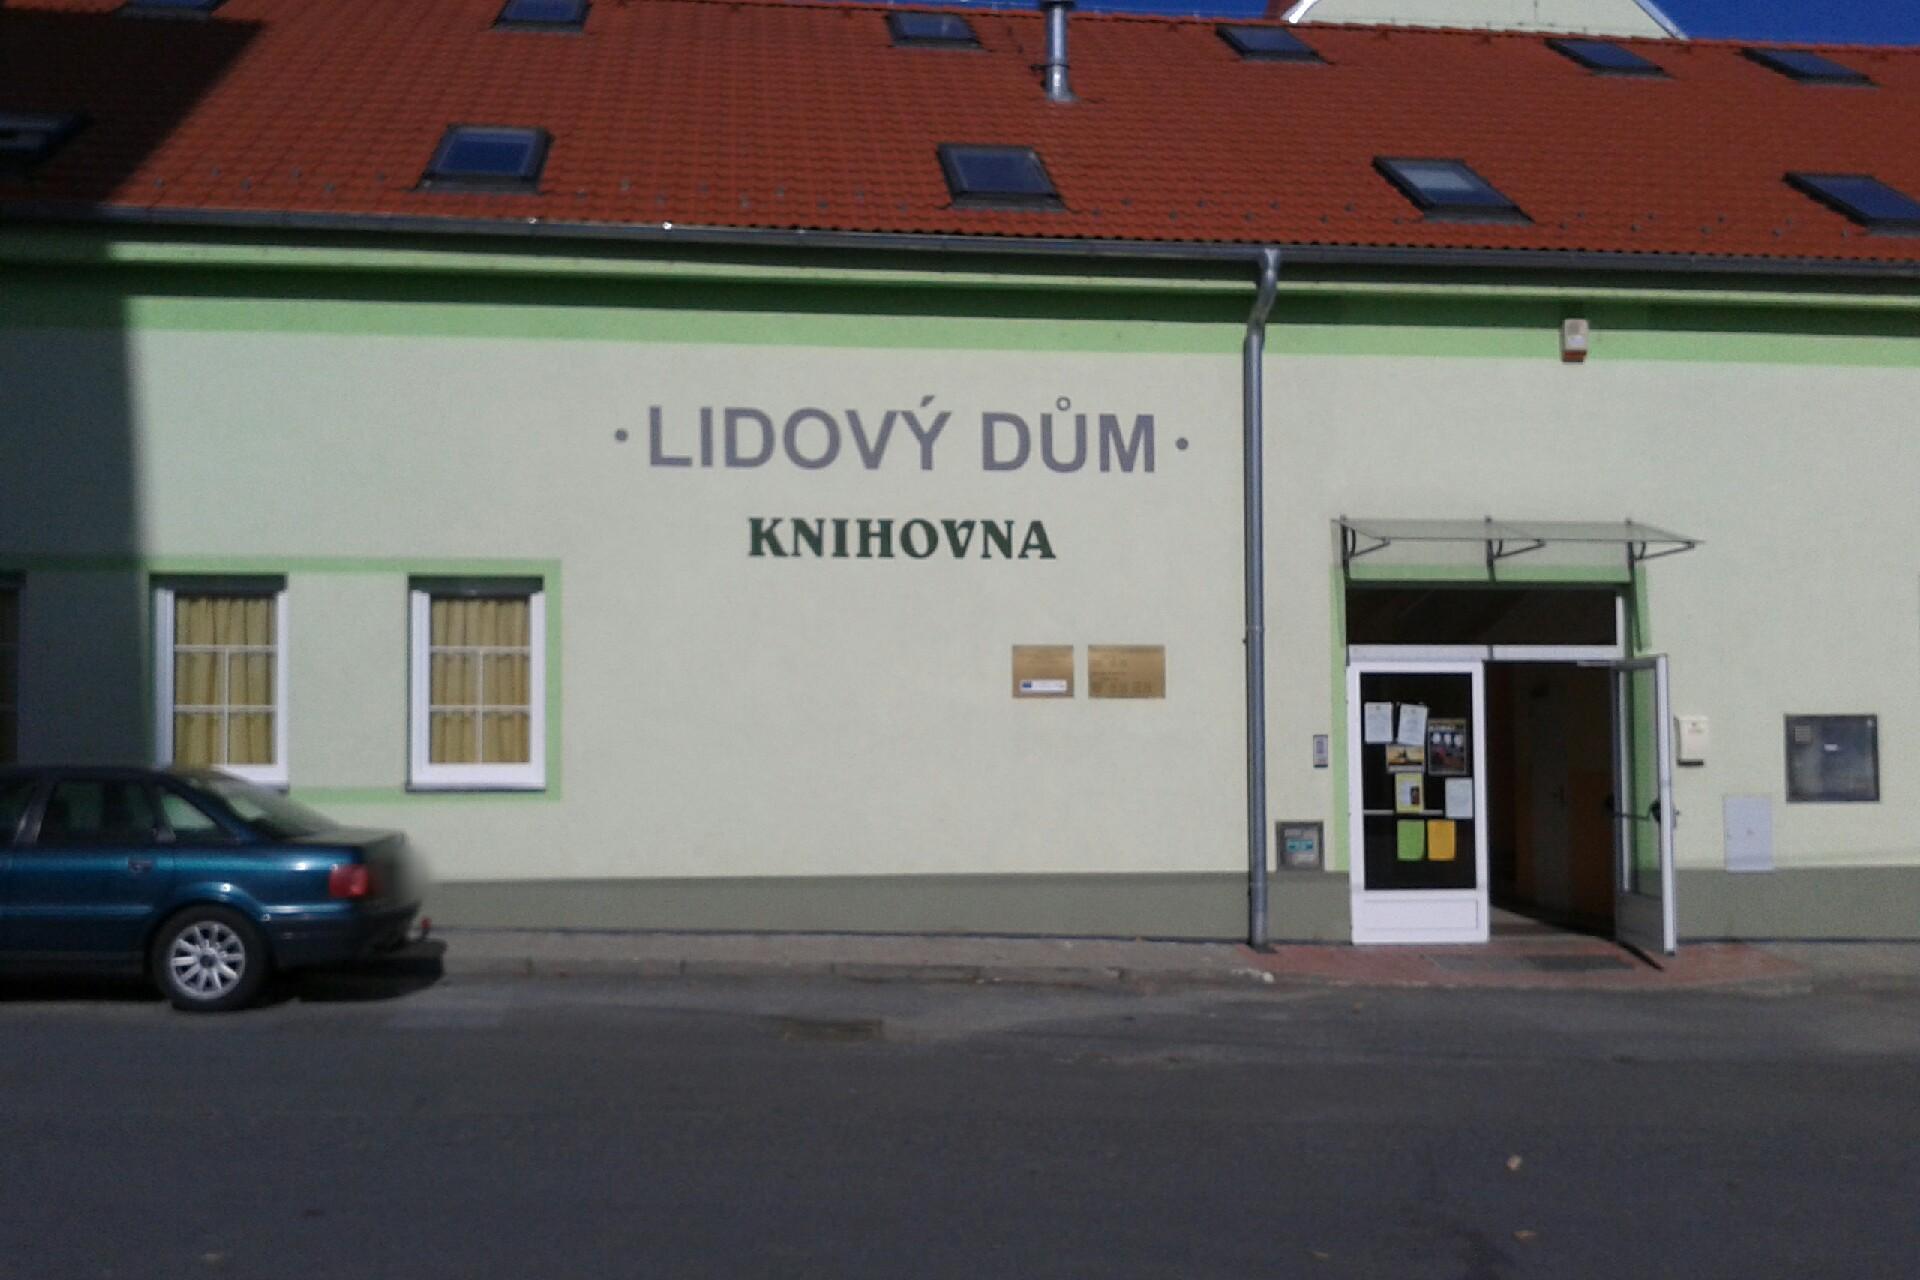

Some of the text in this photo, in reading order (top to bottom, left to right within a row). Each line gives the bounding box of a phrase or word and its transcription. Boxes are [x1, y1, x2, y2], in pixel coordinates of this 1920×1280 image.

[649, 395, 1156, 475] LIDOVÝ DŮM
[748, 516, 1057, 561] KNIHOVNA
